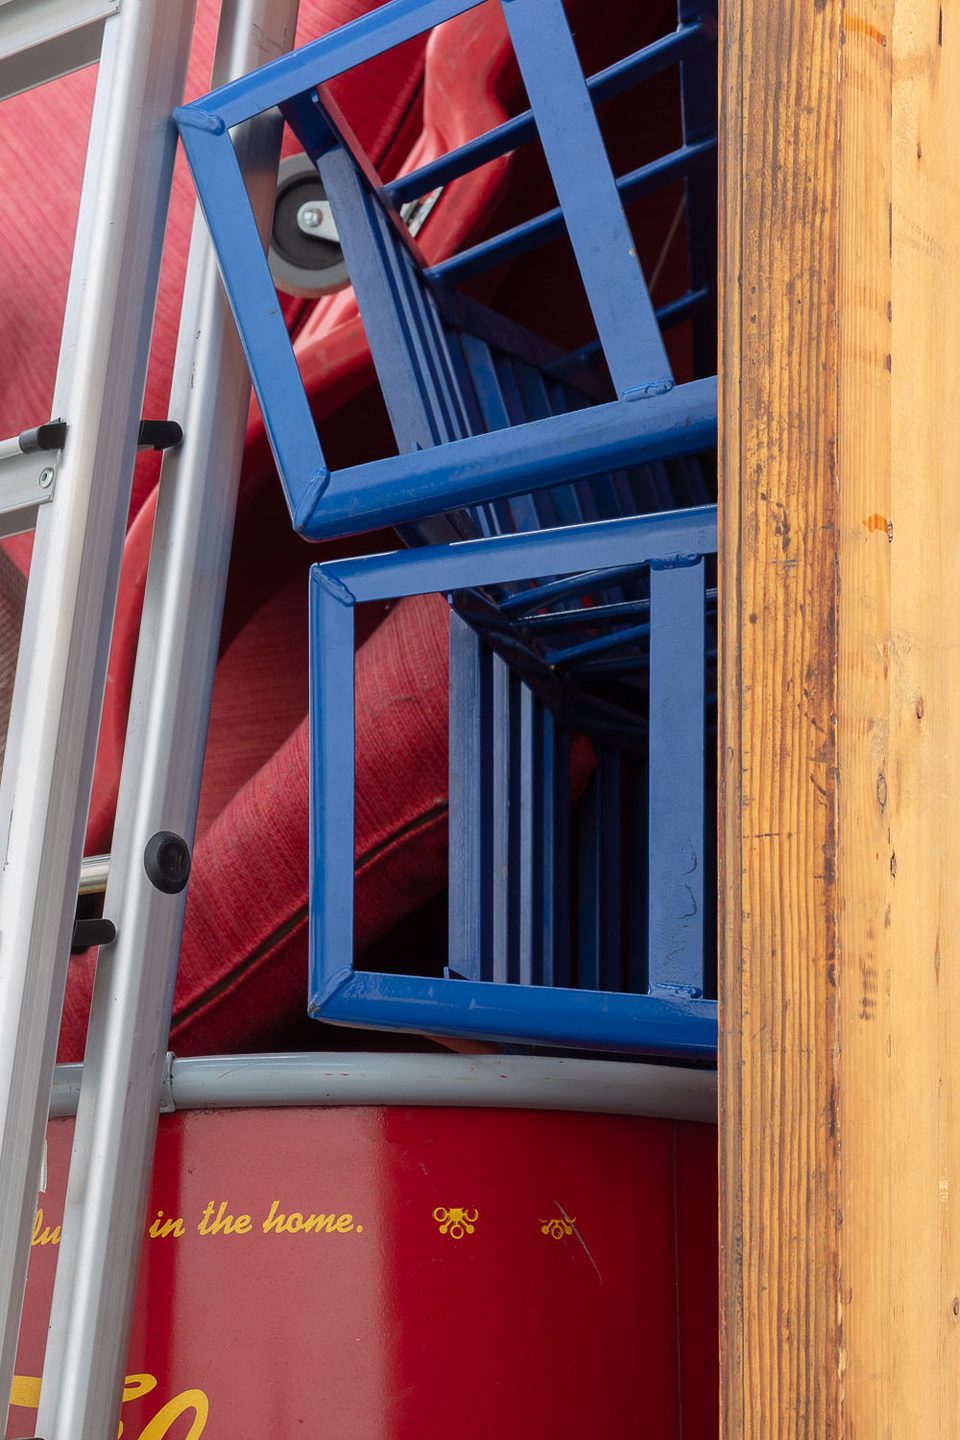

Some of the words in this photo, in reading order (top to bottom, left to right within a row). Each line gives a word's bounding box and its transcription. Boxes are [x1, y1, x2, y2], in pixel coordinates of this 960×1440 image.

[148, 1211, 185, 1238] in
[198, 1201, 253, 1235] the
[262, 1200, 364, 1234] home.
